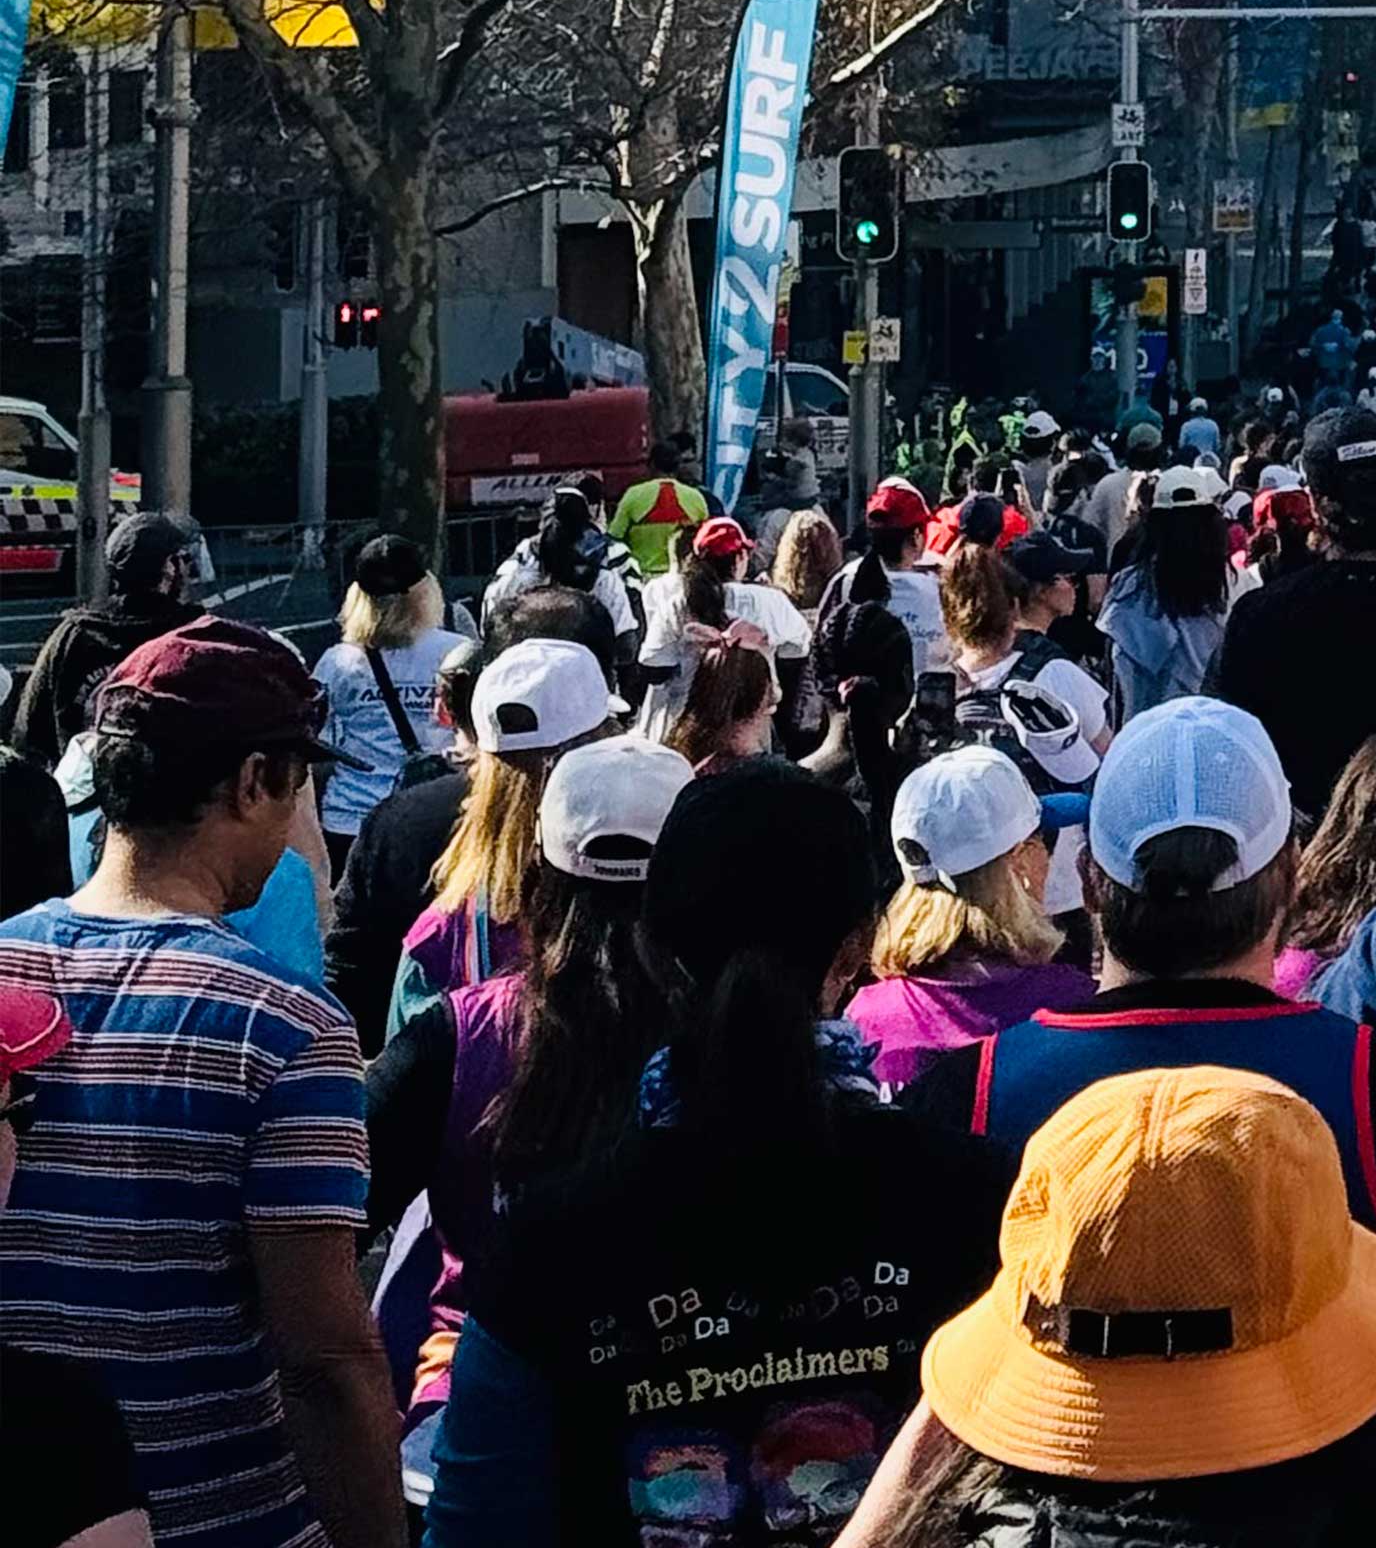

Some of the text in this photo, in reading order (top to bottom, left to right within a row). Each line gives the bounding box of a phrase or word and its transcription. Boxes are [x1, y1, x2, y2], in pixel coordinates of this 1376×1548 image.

[872, 1259, 912, 1287] Da
[648, 1286, 705, 1330] Da
[862, 1293, 900, 1321] Da
[693, 1315, 732, 1341] Da
[588, 1343, 617, 1365] Da
[625, 1345, 891, 1416] The Proclaimers
